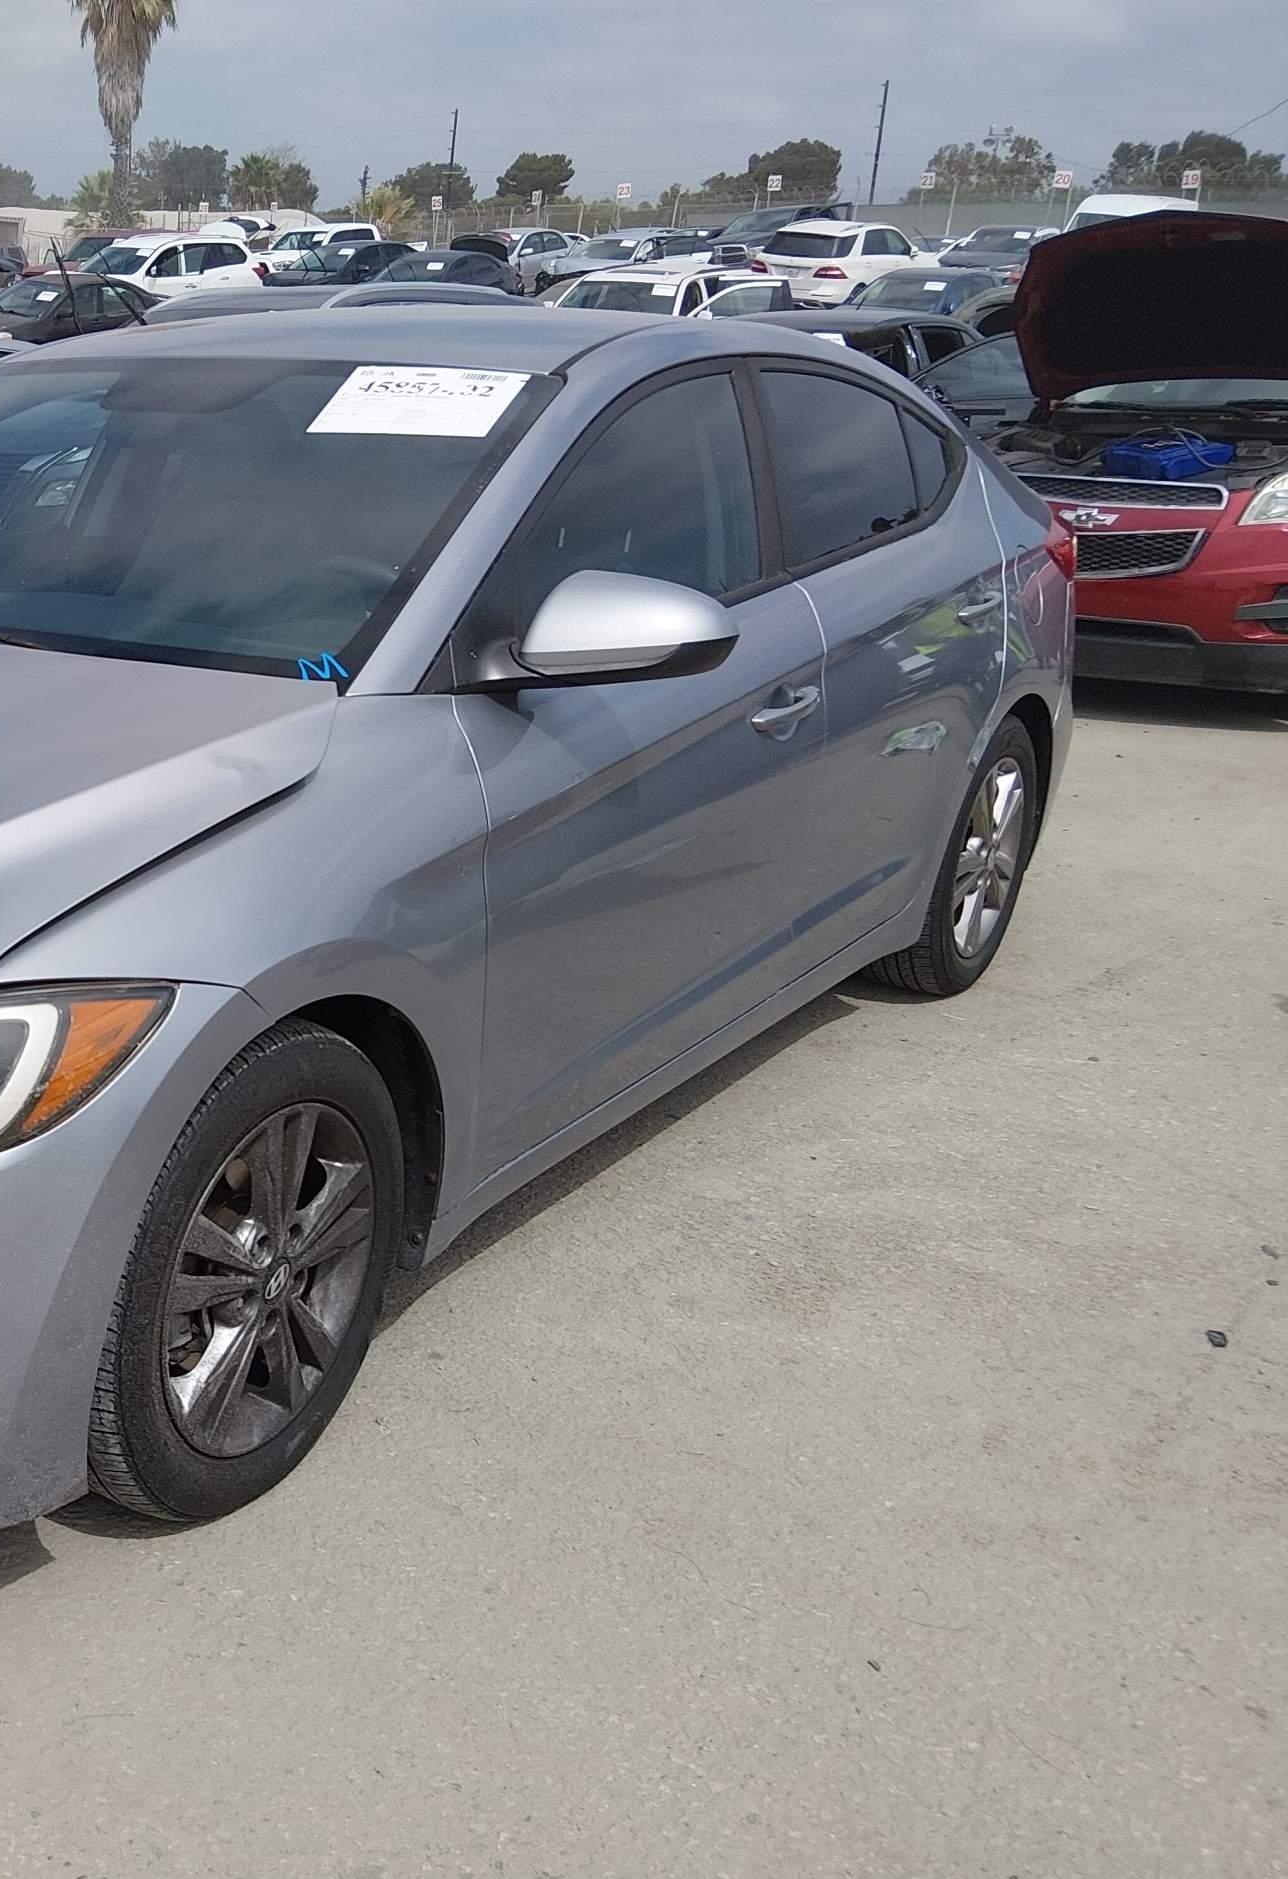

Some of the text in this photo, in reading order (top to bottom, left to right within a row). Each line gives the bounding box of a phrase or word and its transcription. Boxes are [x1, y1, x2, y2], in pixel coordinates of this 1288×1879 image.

[769, 178, 781, 189] 22
[921, 175, 934, 185] 21
[1055, 174, 1071, 185] 20
[1183, 174, 1198, 185] 19
[618, 186, 631, 196] 23
[432, 198, 442, 208] 25
